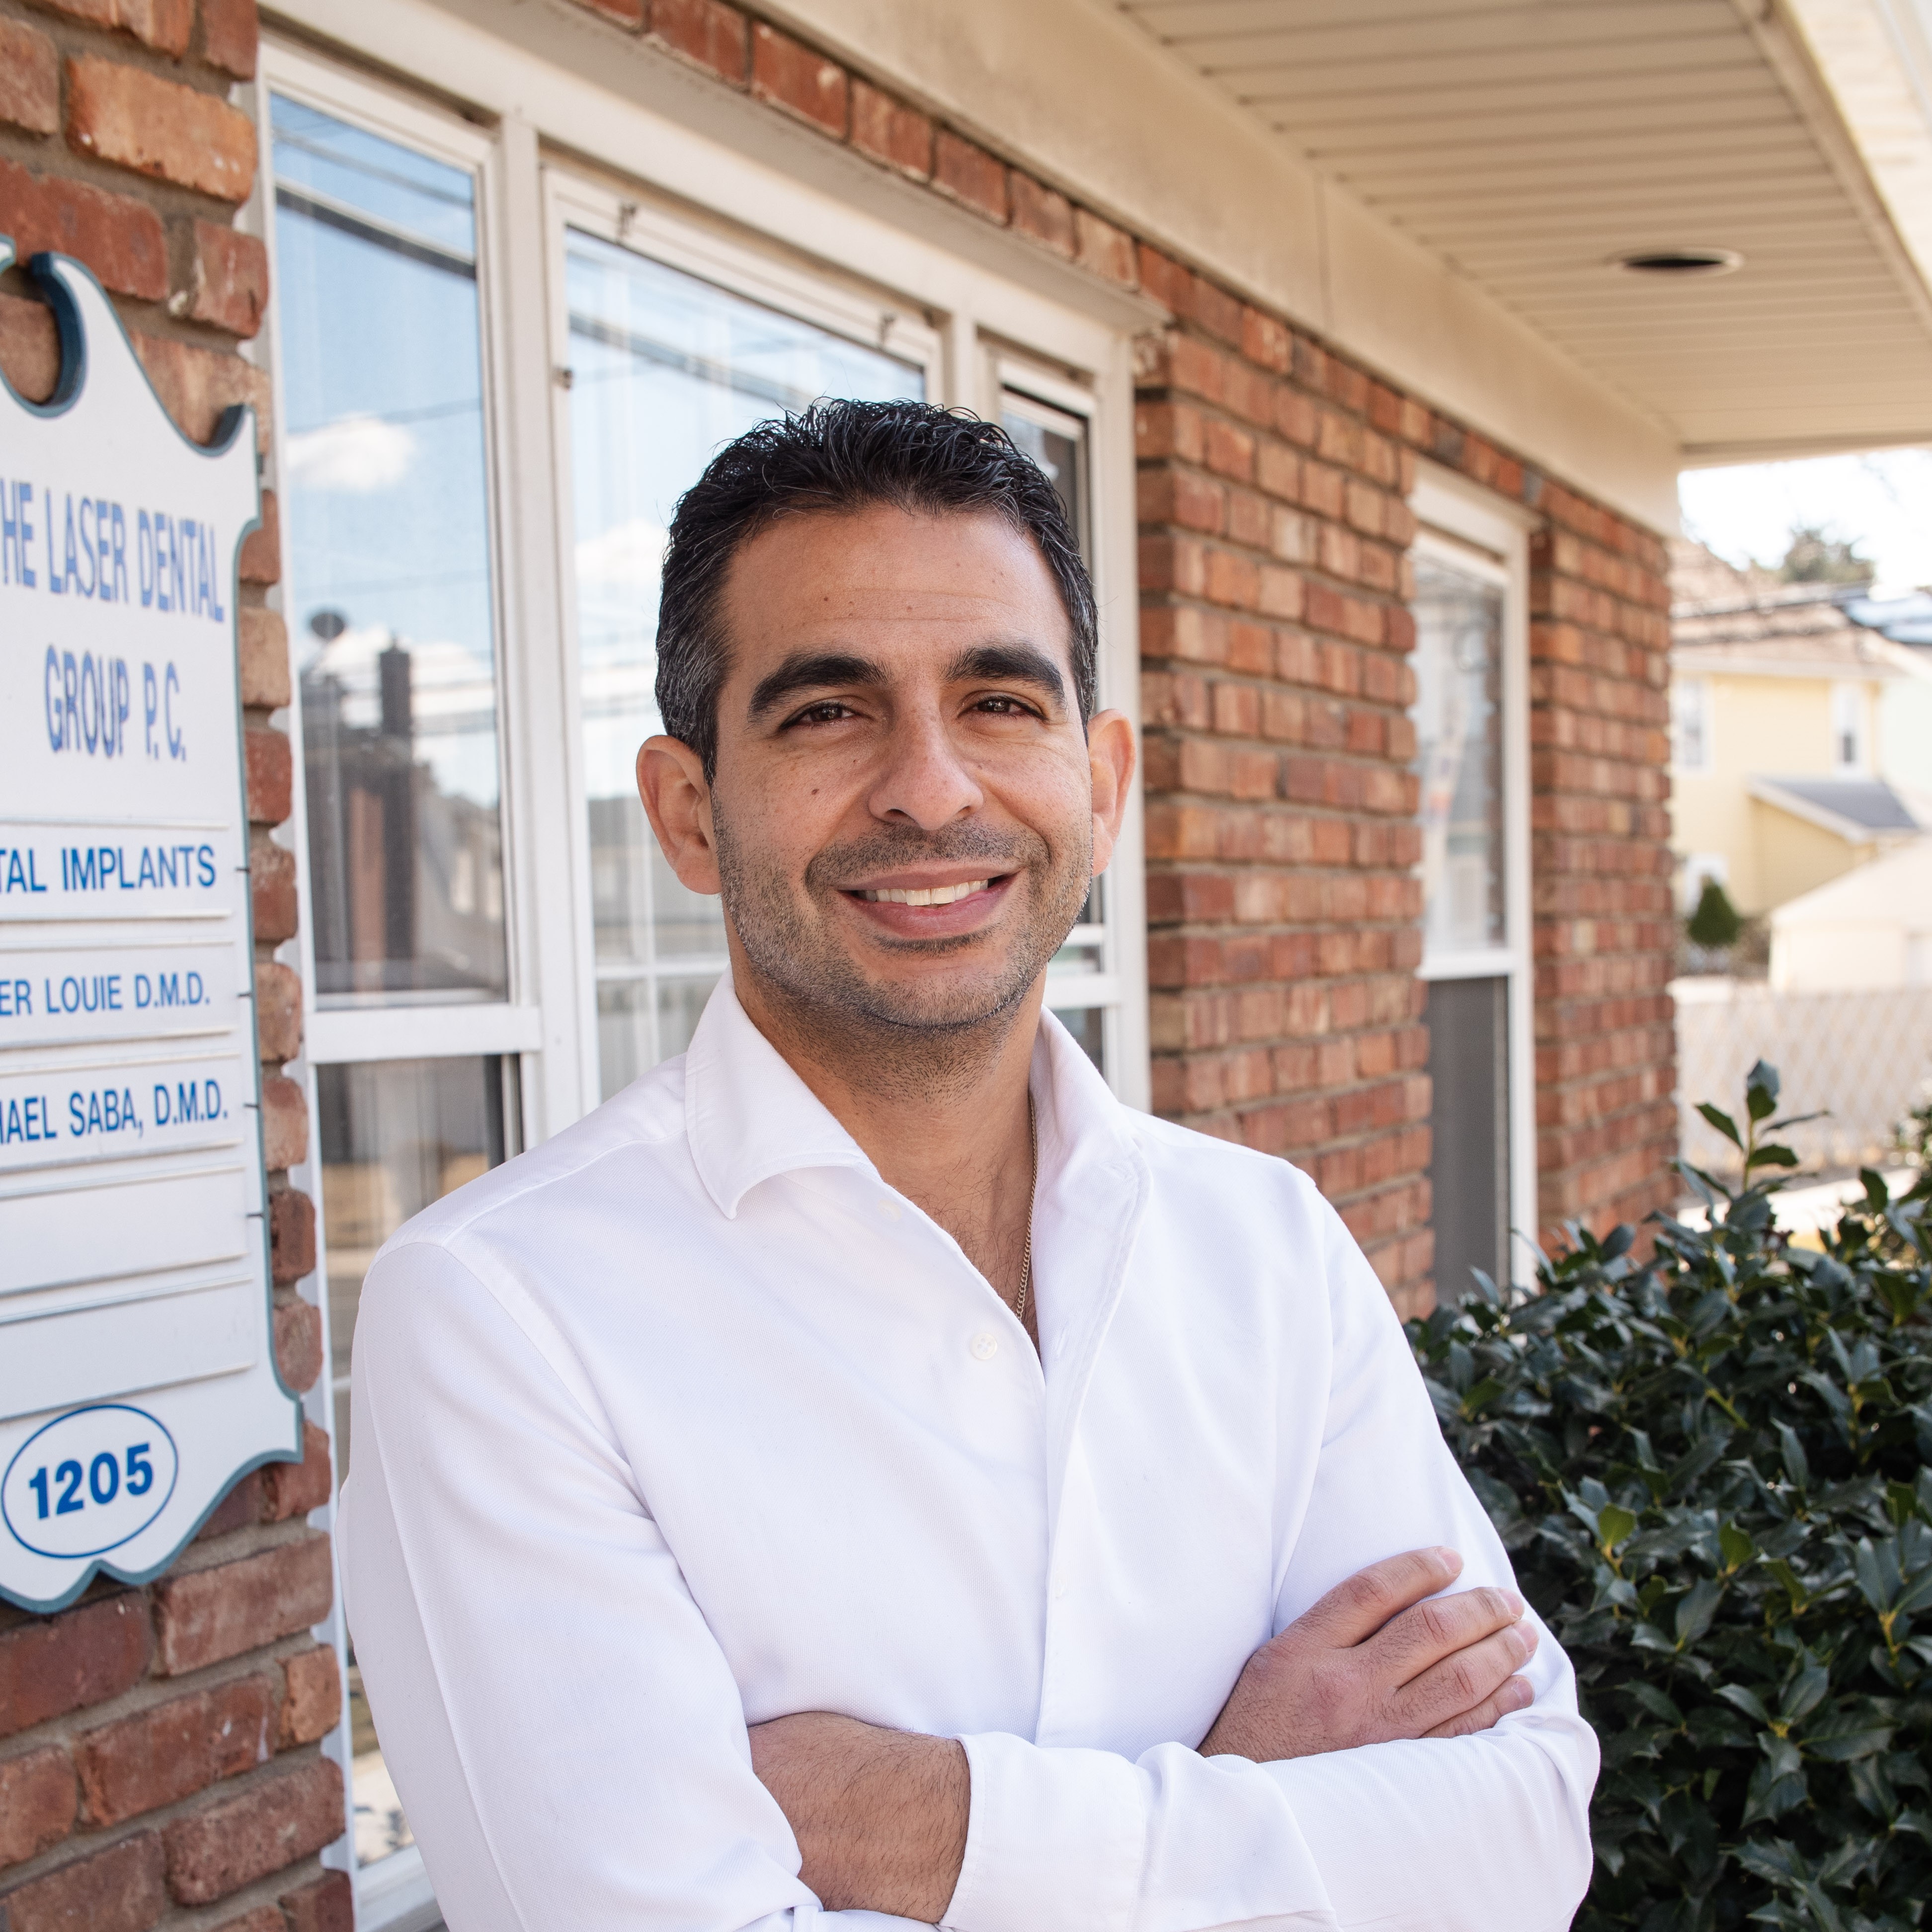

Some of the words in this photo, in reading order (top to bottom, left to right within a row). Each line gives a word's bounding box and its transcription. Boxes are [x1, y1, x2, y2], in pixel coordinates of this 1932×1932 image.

[0, 478, 36, 588] HE
[45, 488, 129, 604] LASER
[138, 508, 224, 623] DENTAL
[45, 645, 129, 757] GROUP
[61, 843, 217, 892] IMPLANTS
[0, 978, 32, 1017] ER
[44, 974, 123, 1014] LOUIE
[133, 971, 210, 1009] D.M.D.
[68, 1087, 144, 1138] SABA,
[153, 1079, 228, 1127] D.M.D.
[28, 1442, 154, 1521] 1205
